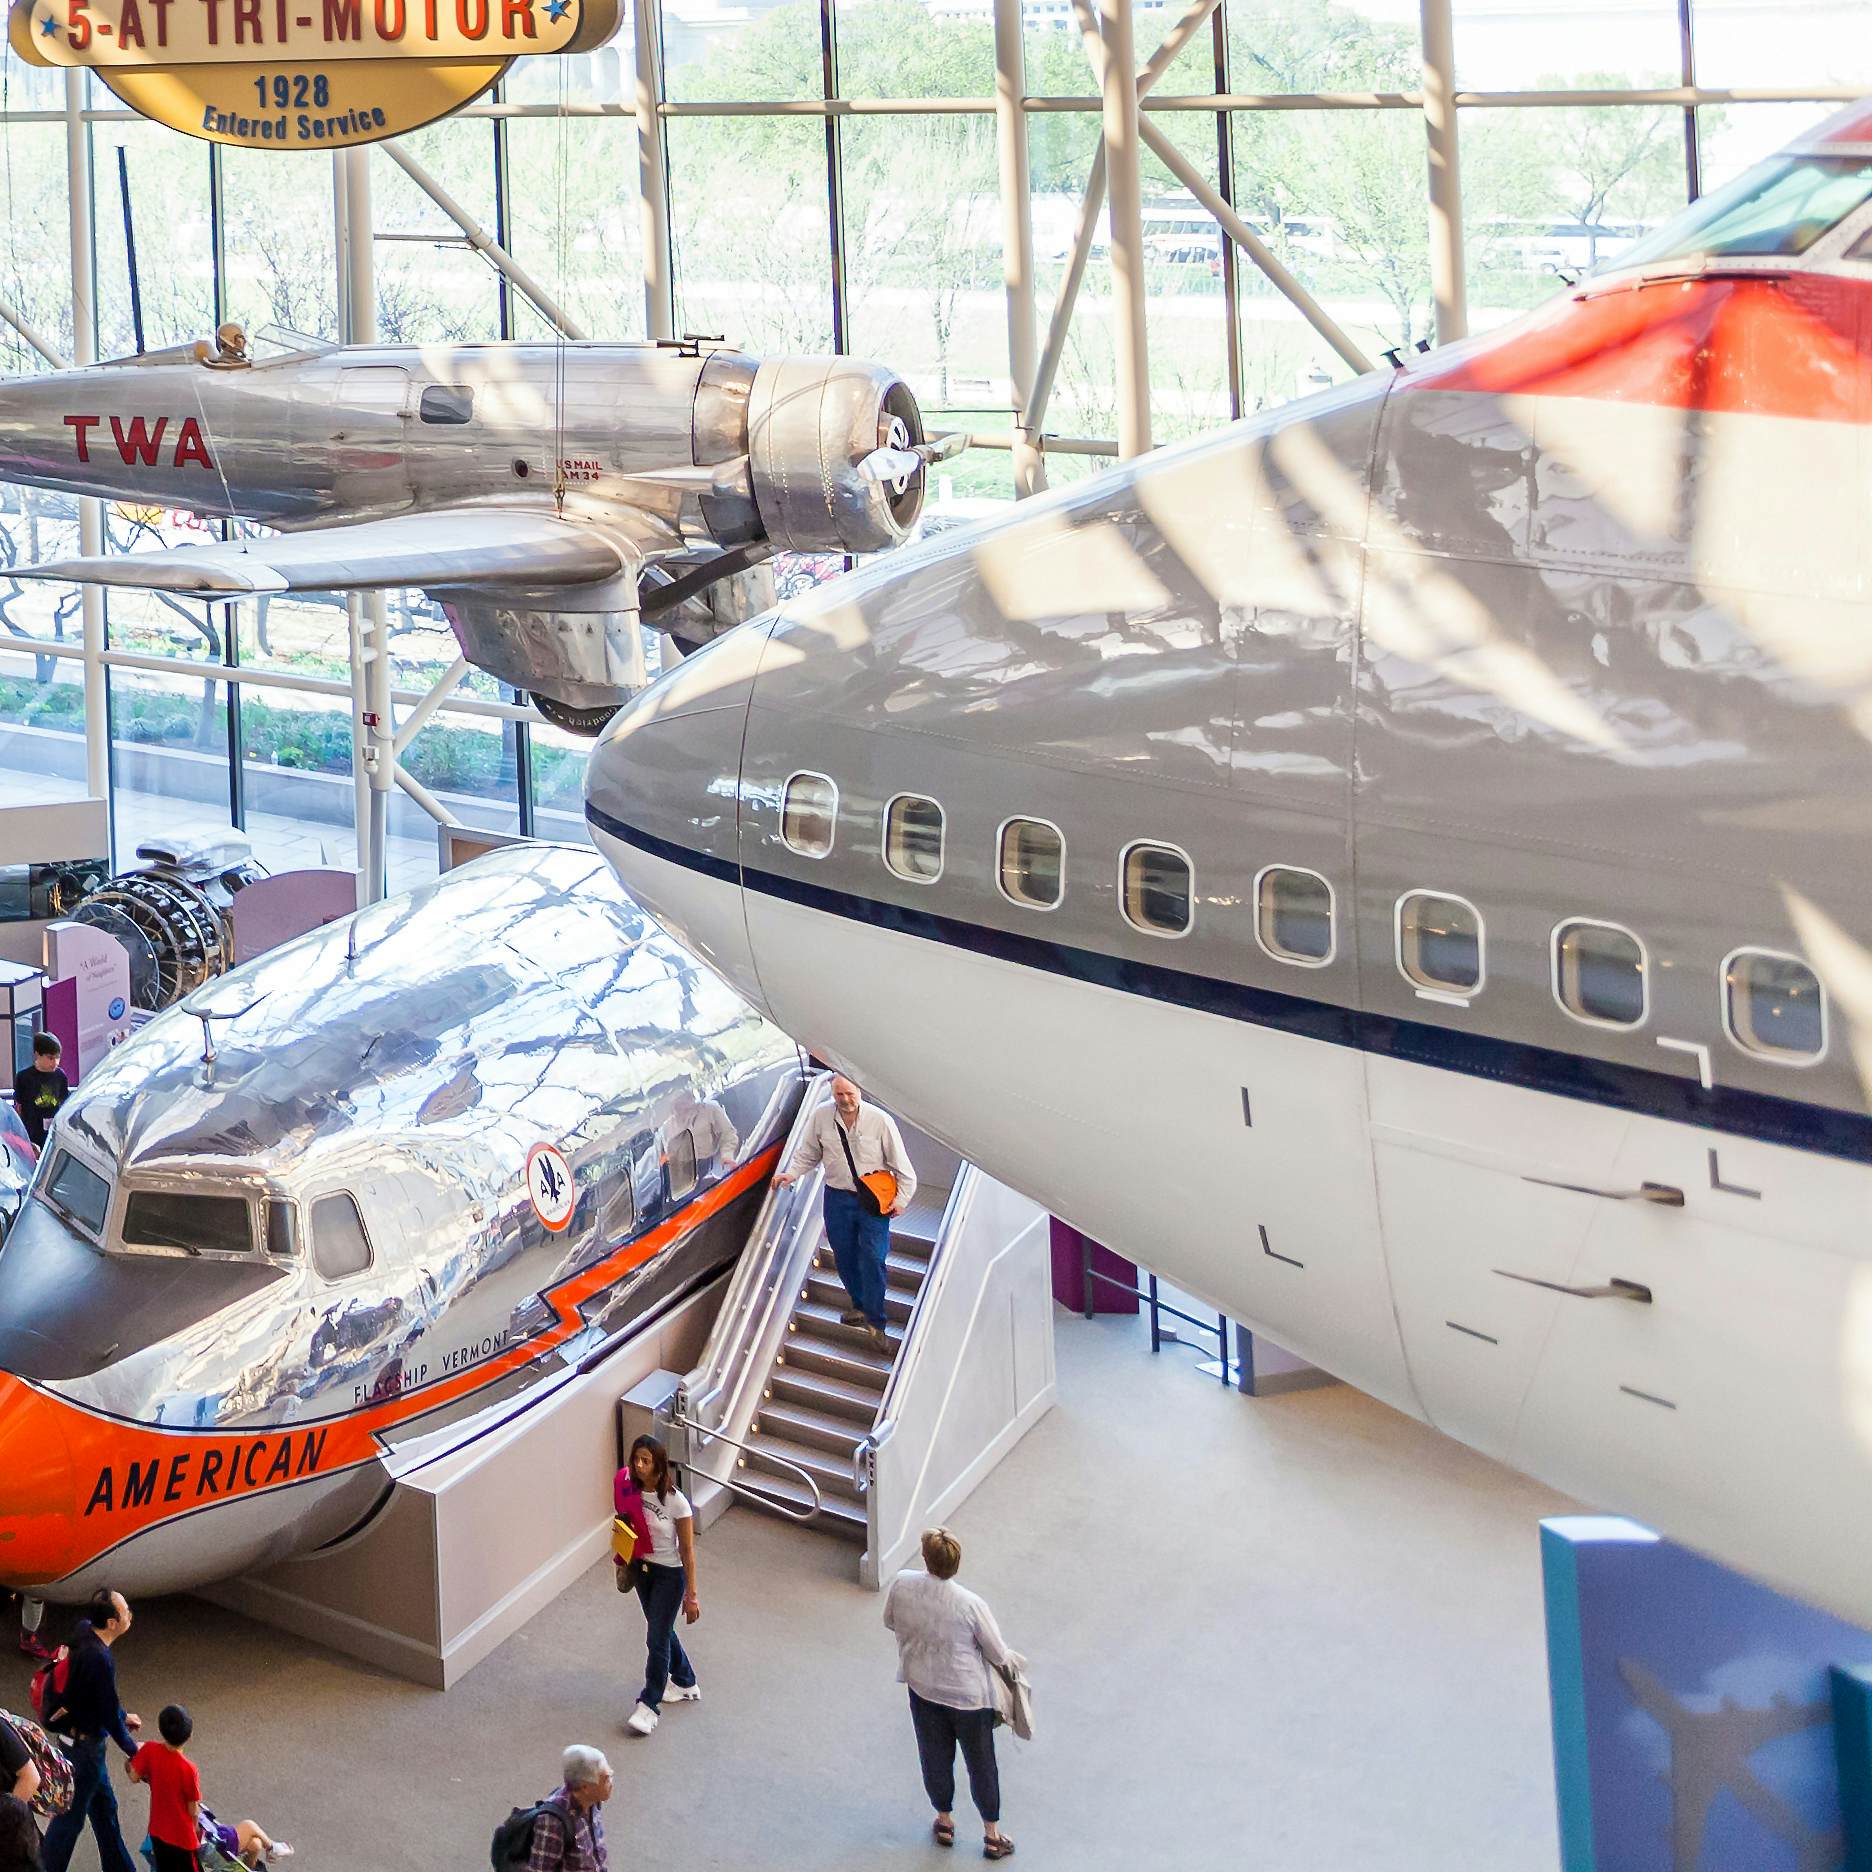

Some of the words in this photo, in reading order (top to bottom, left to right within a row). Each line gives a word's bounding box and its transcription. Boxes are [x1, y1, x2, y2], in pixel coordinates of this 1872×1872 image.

[254, 74, 331, 109] 1928
[203, 104, 289, 141] Entered
[297, 105, 387, 141] Service
[63, 415, 214, 470] TWA
[574, 460, 603, 470] MAIL
[583, 471, 600, 481] 34
[353, 1363, 429, 1405] FLAGSHIP
[441, 1328, 510, 1372] VERMONT
[83, 1428, 328, 1517] AMERICAN
